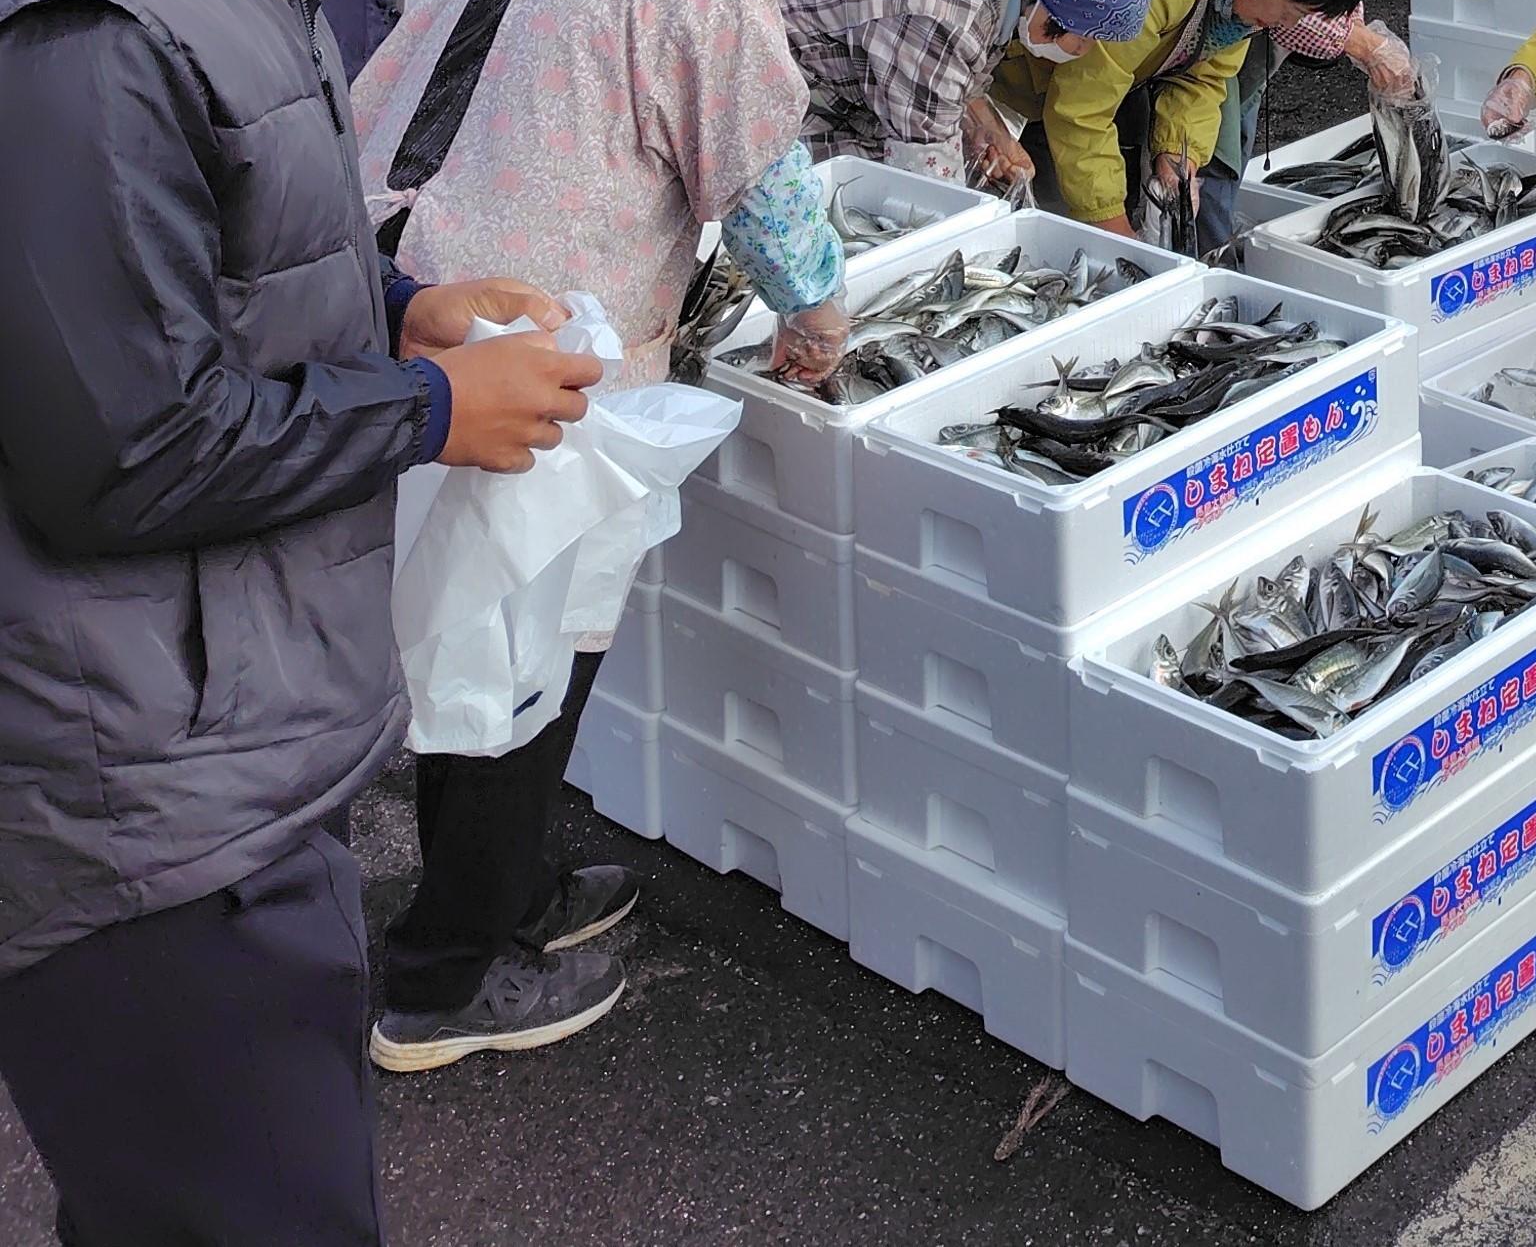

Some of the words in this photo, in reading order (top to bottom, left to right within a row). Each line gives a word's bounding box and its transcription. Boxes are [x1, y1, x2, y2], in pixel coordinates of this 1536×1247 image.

[1185, 402, 1344, 508] しまね定置もん
